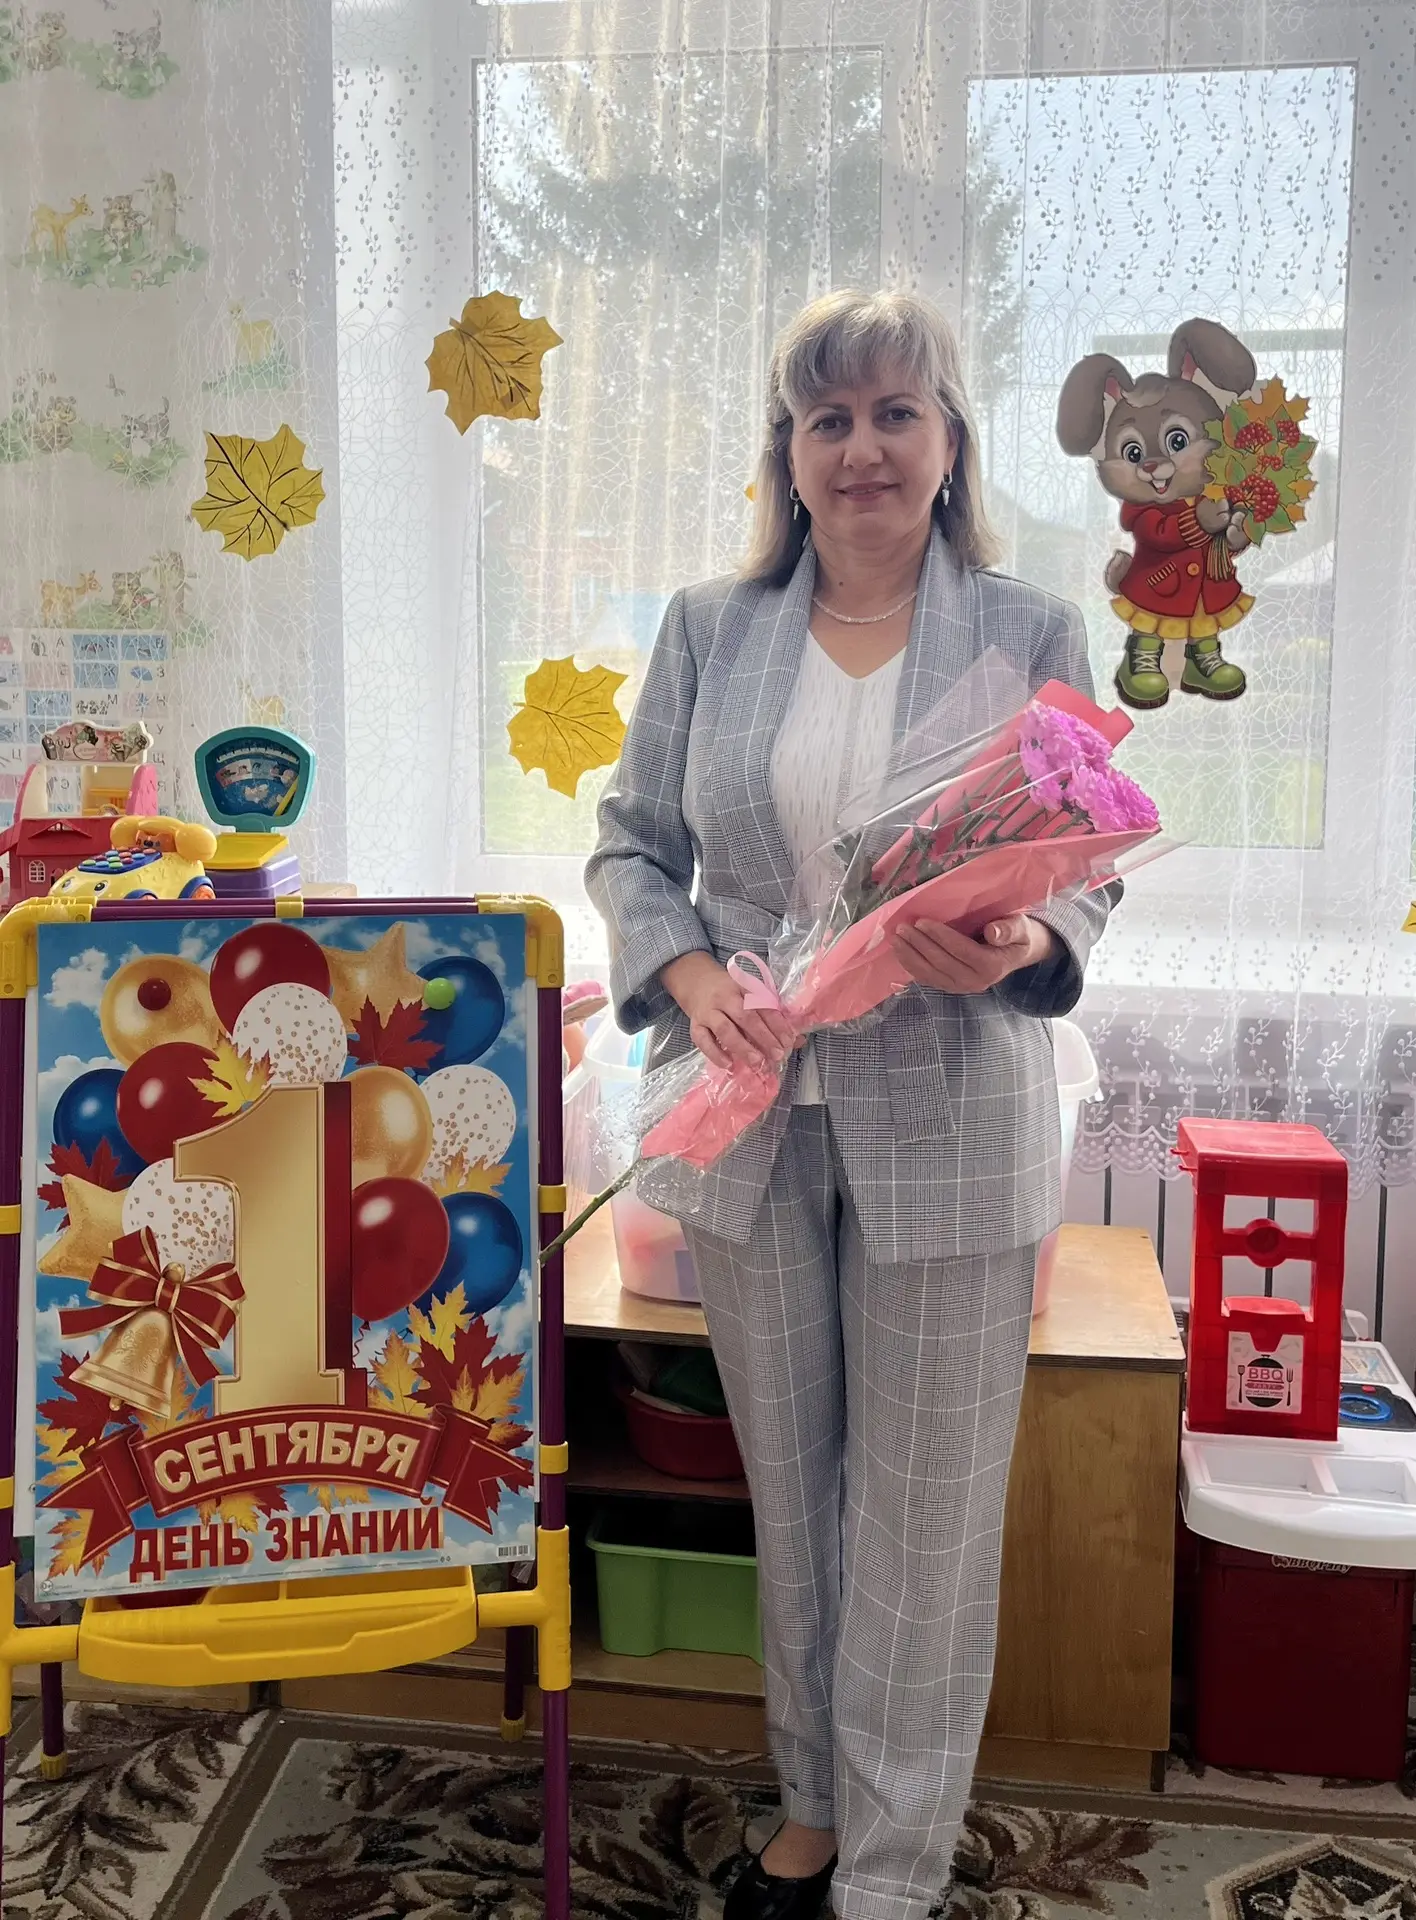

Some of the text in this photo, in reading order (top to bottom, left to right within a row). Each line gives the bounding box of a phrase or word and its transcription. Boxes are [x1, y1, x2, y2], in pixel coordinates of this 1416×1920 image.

[173, 1081, 366, 1416] 1
[1249, 1367, 1283, 1382] BBQ
[153, 1420, 420, 1494] СЕНТЯБРЯ
[129, 1496, 443, 1584] ДЕНЬ ЗНАНИЙ
